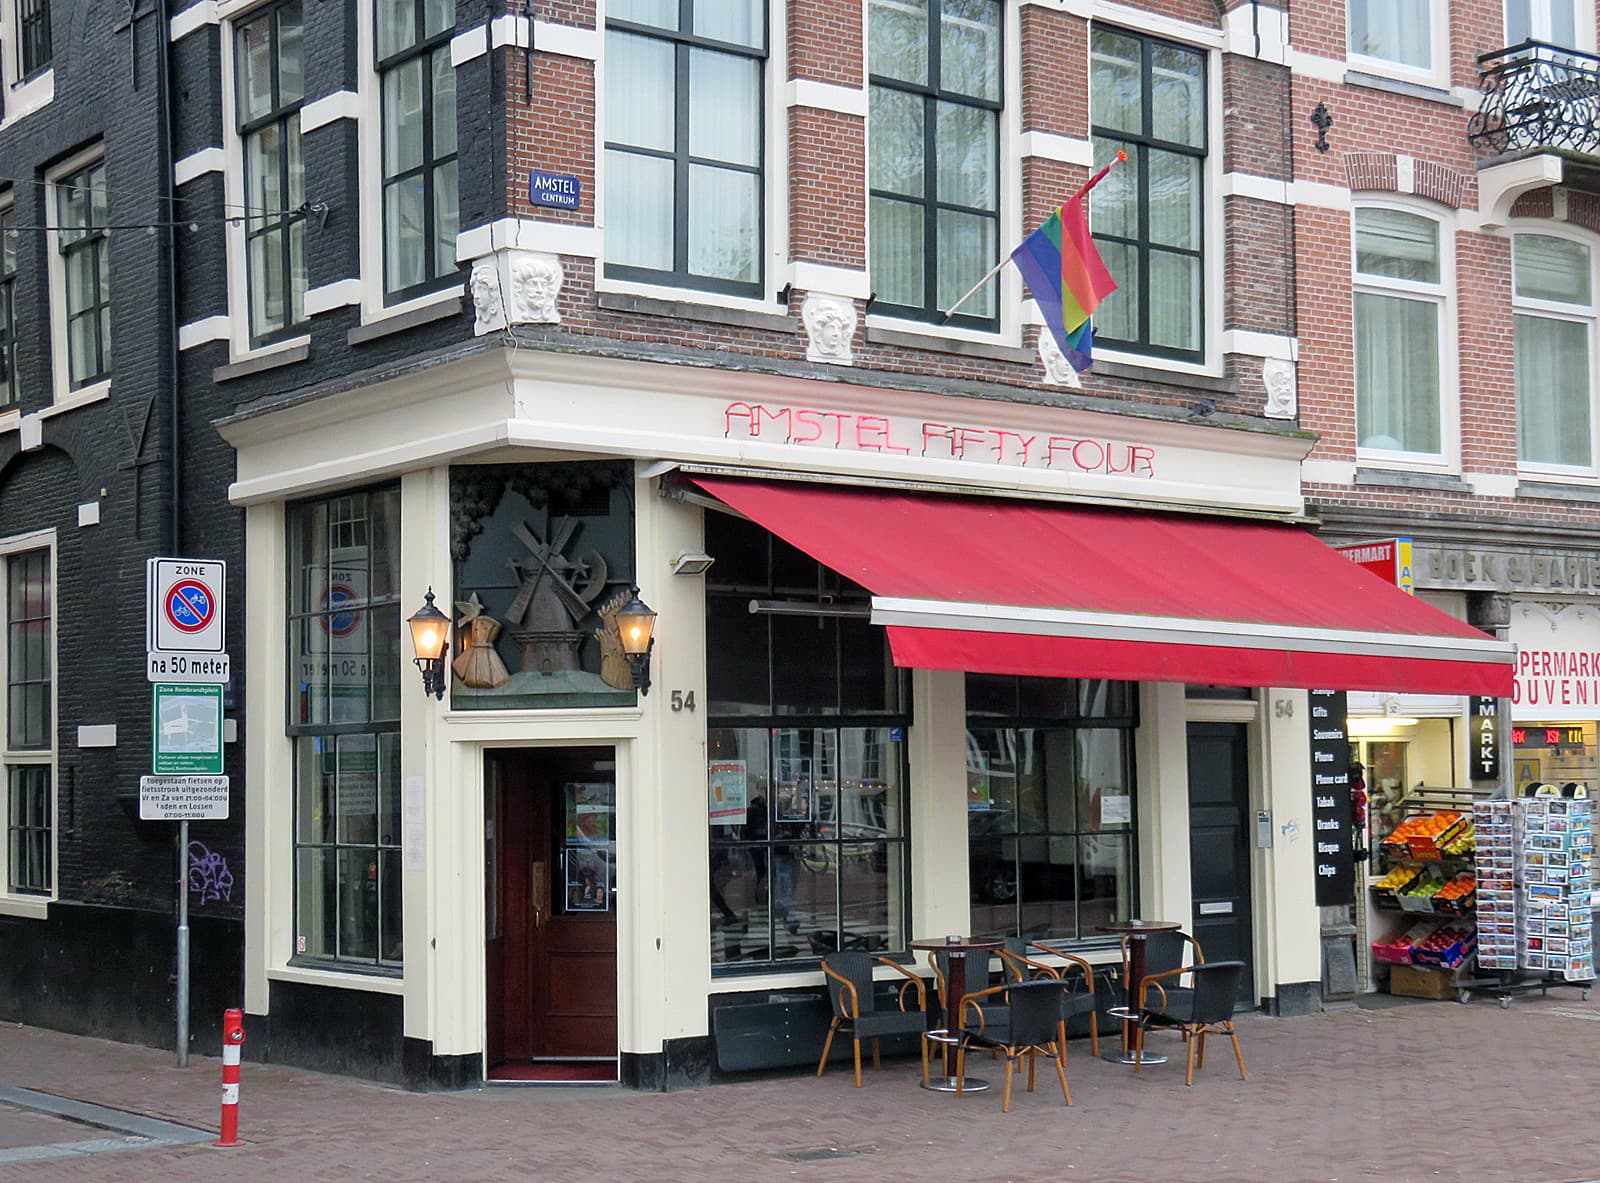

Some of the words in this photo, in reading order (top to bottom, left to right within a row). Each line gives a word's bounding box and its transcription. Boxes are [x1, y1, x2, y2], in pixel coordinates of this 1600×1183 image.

[535, 176, 575, 194] AMSTEL
[541, 193, 575, 205] CENTRUM
[725, 402, 911, 452] AMSTEL
[922, 423, 1037, 465] FIFTY
[1047, 436, 1156, 478] FOUR
[1338, 545, 1392, 563] PERMART
[175, 566, 206, 576] ZONE
[1428, 552, 1497, 583] BOEK
[1507, 556, 1525, 584] &
[151, 659, 167, 673] na
[171, 657, 187, 674] 50
[191, 658, 228, 675] meter
[670, 690, 696, 713] 54
[1275, 699, 1295, 719] 54
[1313, 728, 1344, 740] Souvenirs
[1314, 751, 1335, 762] Phone
[147, 778, 187, 786] toegestaan
[187, 777, 213, 785] fietsen
[213, 778, 224, 786] op
[1315, 773, 1334, 785] Phone
[181, 786, 228, 794] uitgezonderd
[161, 794, 170, 802] Za
